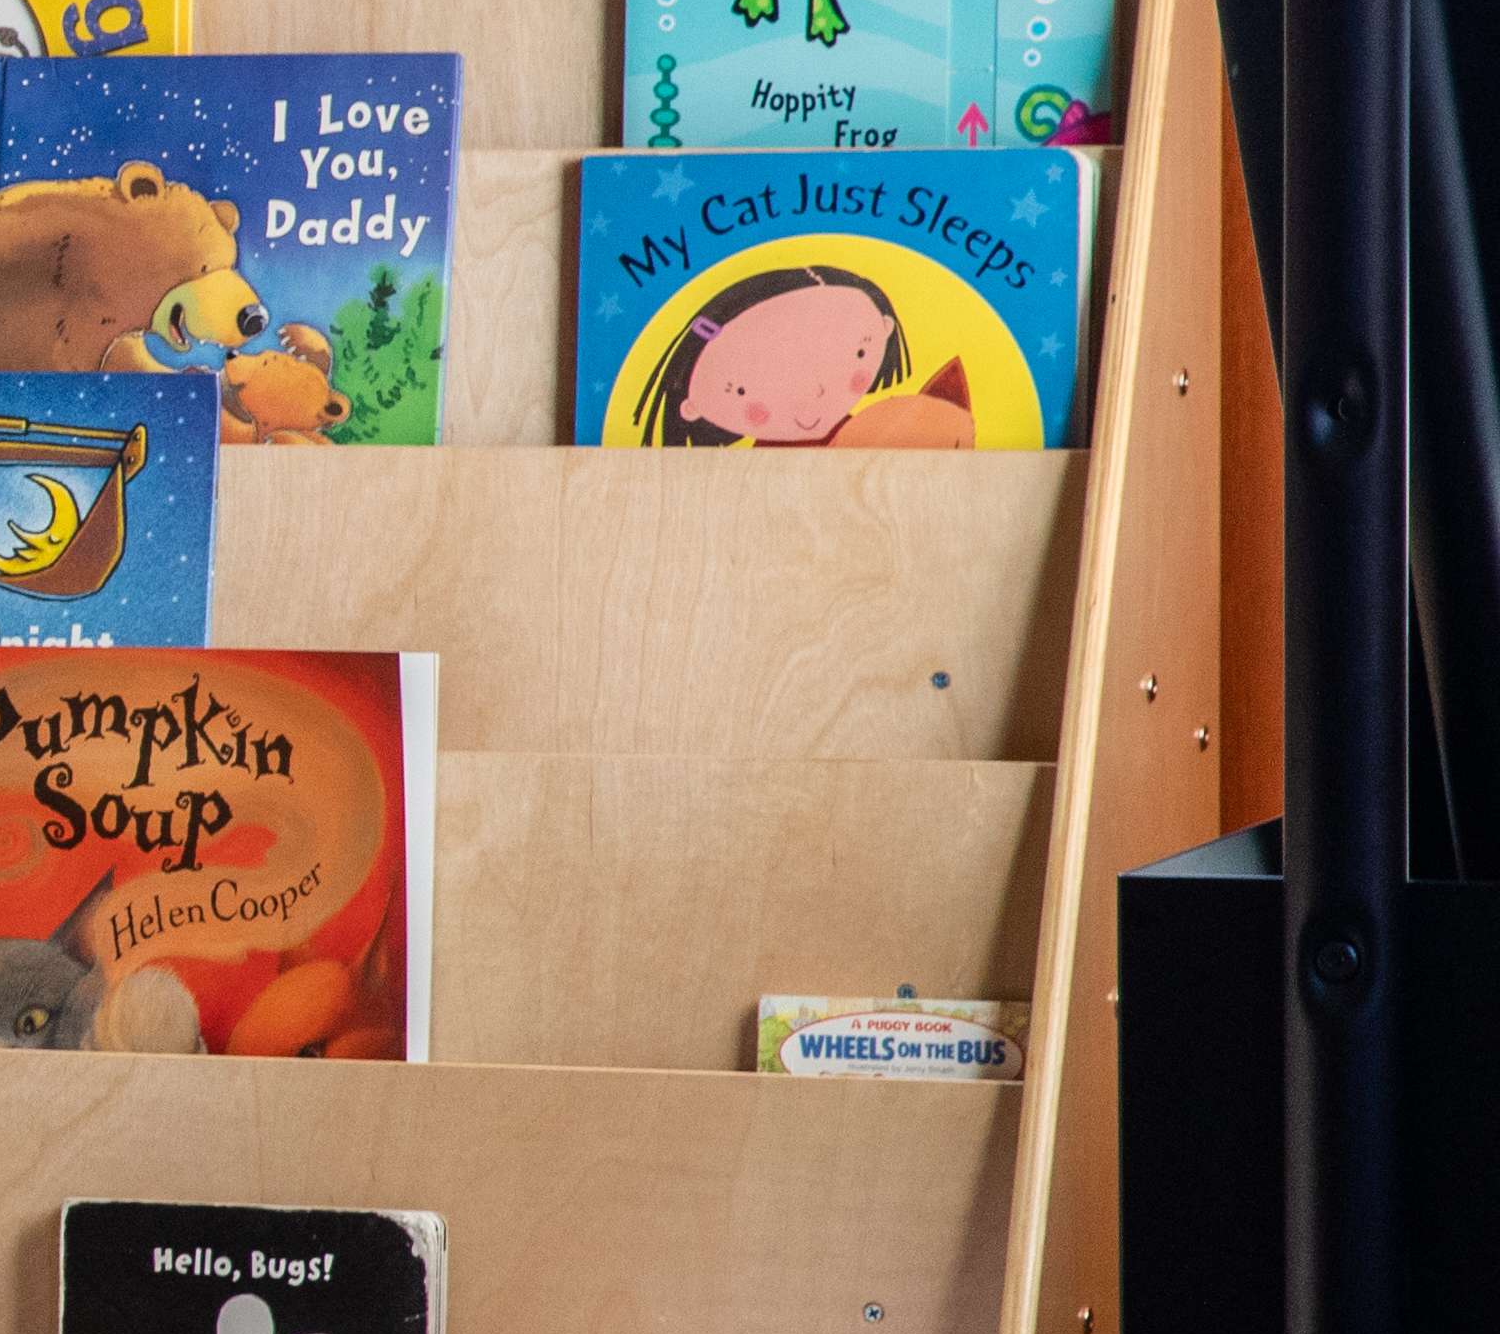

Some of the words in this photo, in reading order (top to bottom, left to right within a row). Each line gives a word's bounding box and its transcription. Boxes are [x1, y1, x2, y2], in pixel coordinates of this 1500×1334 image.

[272, 99, 288, 143] I
[318, 93, 431, 137] Love
[751, 78, 857, 123] Hoppity
[299, 146, 398, 190] You,
[265, 194, 427, 258] Daddy
[617, 226, 692, 289] My
[701, 184, 782, 235] Cat
[792, 173, 888, 218] Just
[898, 185, 1036, 289] Sleeps
[33, 761, 233, 874] Soup
[107, 895, 205, 962] Helen
[209, 861, 325, 926] Cooper
[799, 1034, 895, 1061] WHEELS
[897, 1042, 921, 1059] ON
[925, 1043, 955, 1060] THE
[956, 1040, 1006, 1065] BUS
[915, 1022, 953, 1033] BOOK
[152, 1247, 241, 1283] Hello,
[251, 1250, 335, 1286] Bugs!
